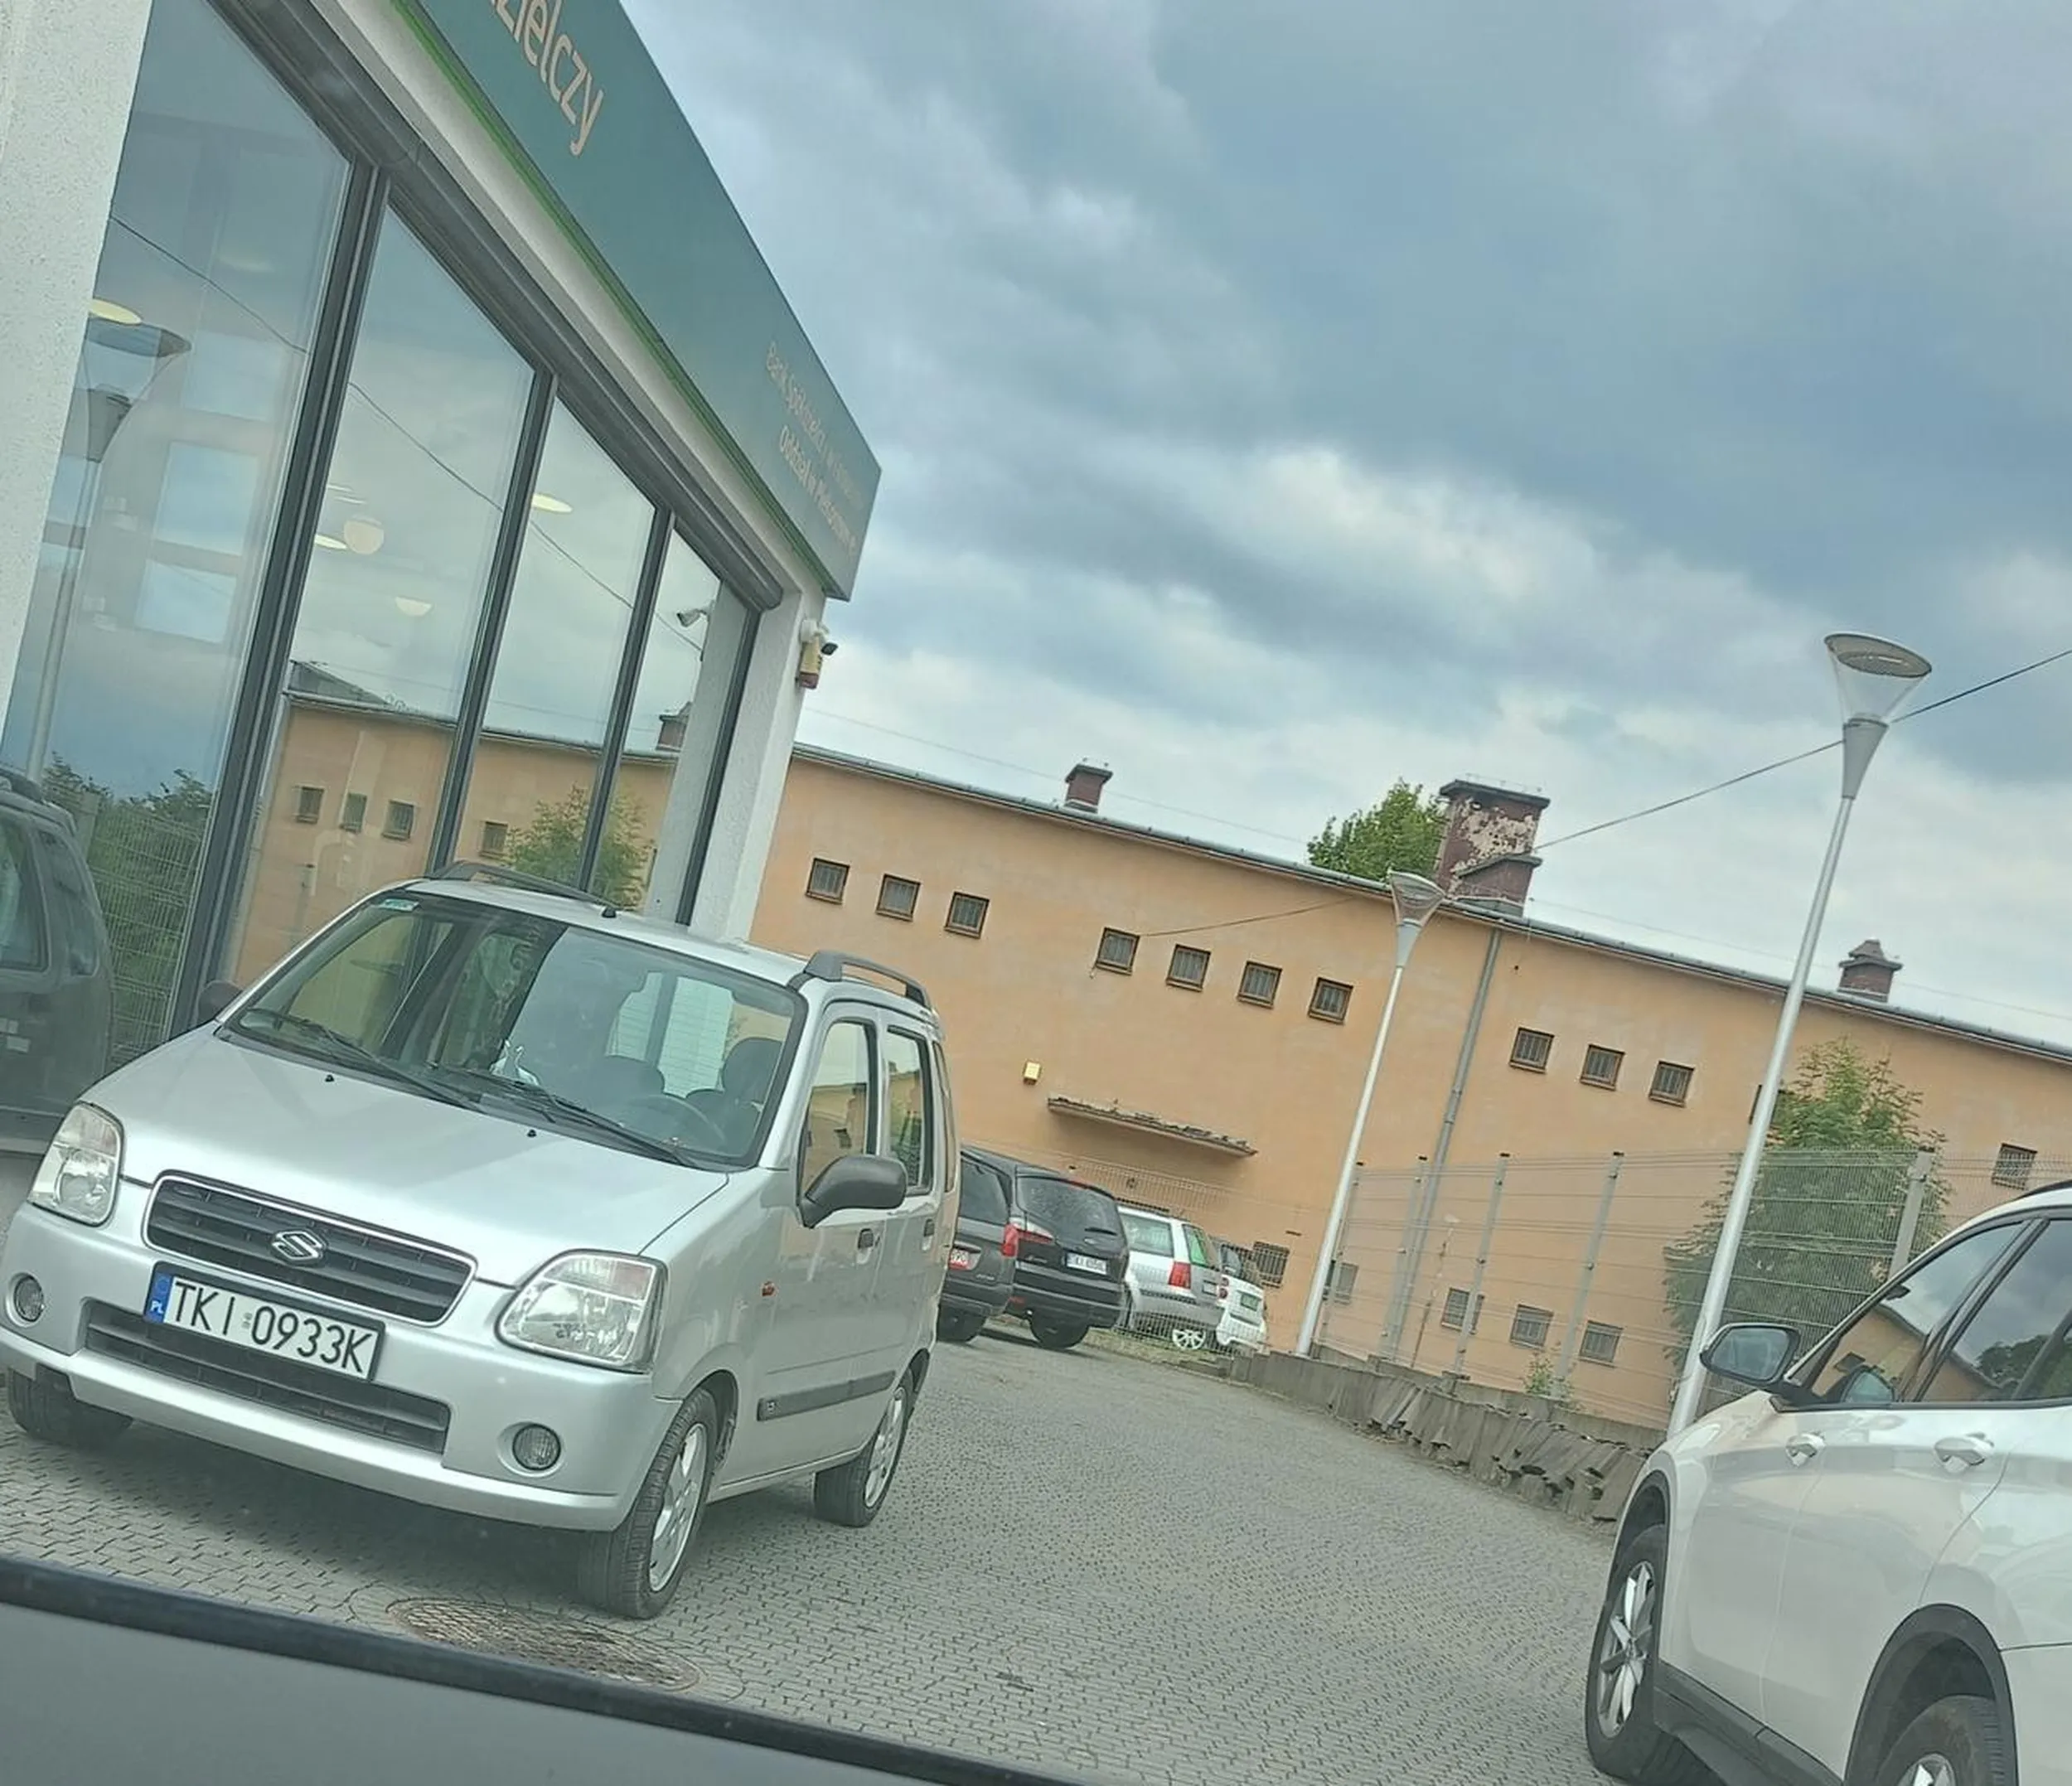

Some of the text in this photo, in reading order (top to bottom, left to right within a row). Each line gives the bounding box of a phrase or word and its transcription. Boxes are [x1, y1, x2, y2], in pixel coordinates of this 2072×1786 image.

[149, 1300, 165, 1315] PL
[175, 1280, 373, 1373] TKI 0933K
